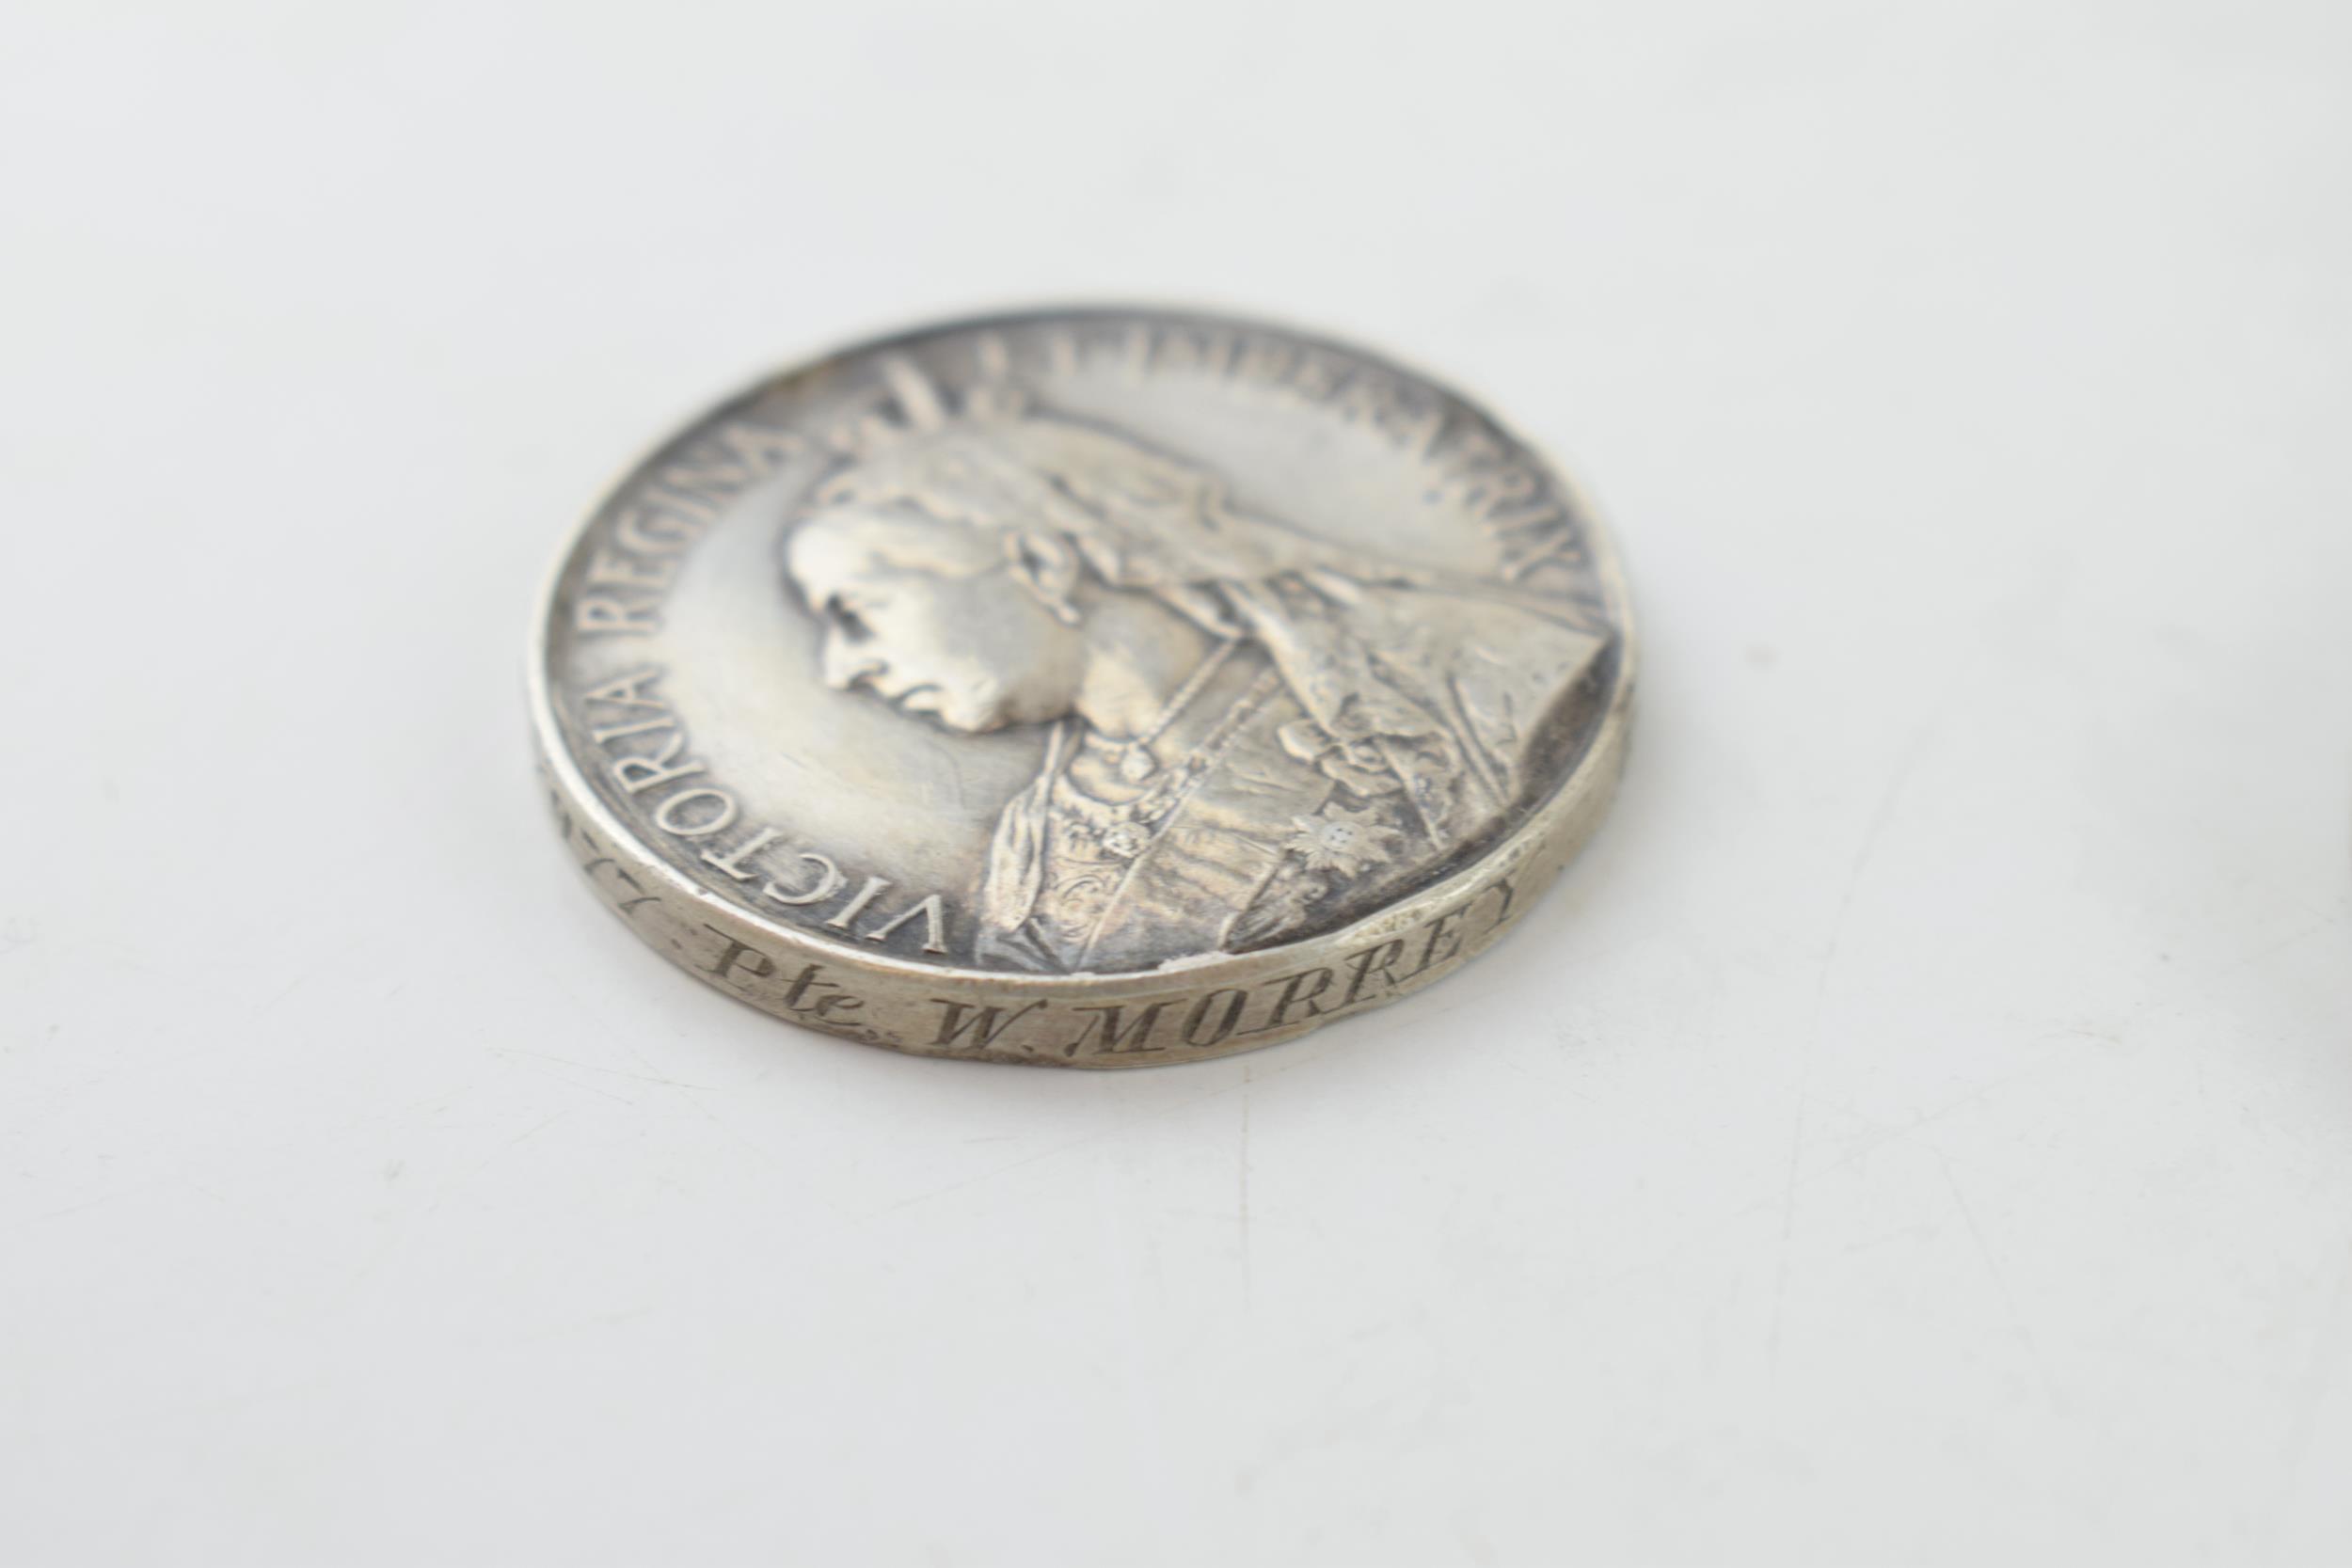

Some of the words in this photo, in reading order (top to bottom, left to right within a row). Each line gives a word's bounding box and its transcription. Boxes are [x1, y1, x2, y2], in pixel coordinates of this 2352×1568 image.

[576, 423, 805, 632] REGINA
[584, 666, 946, 954] VICTORIA
[1064, 845, 1544, 1058] MORREY
